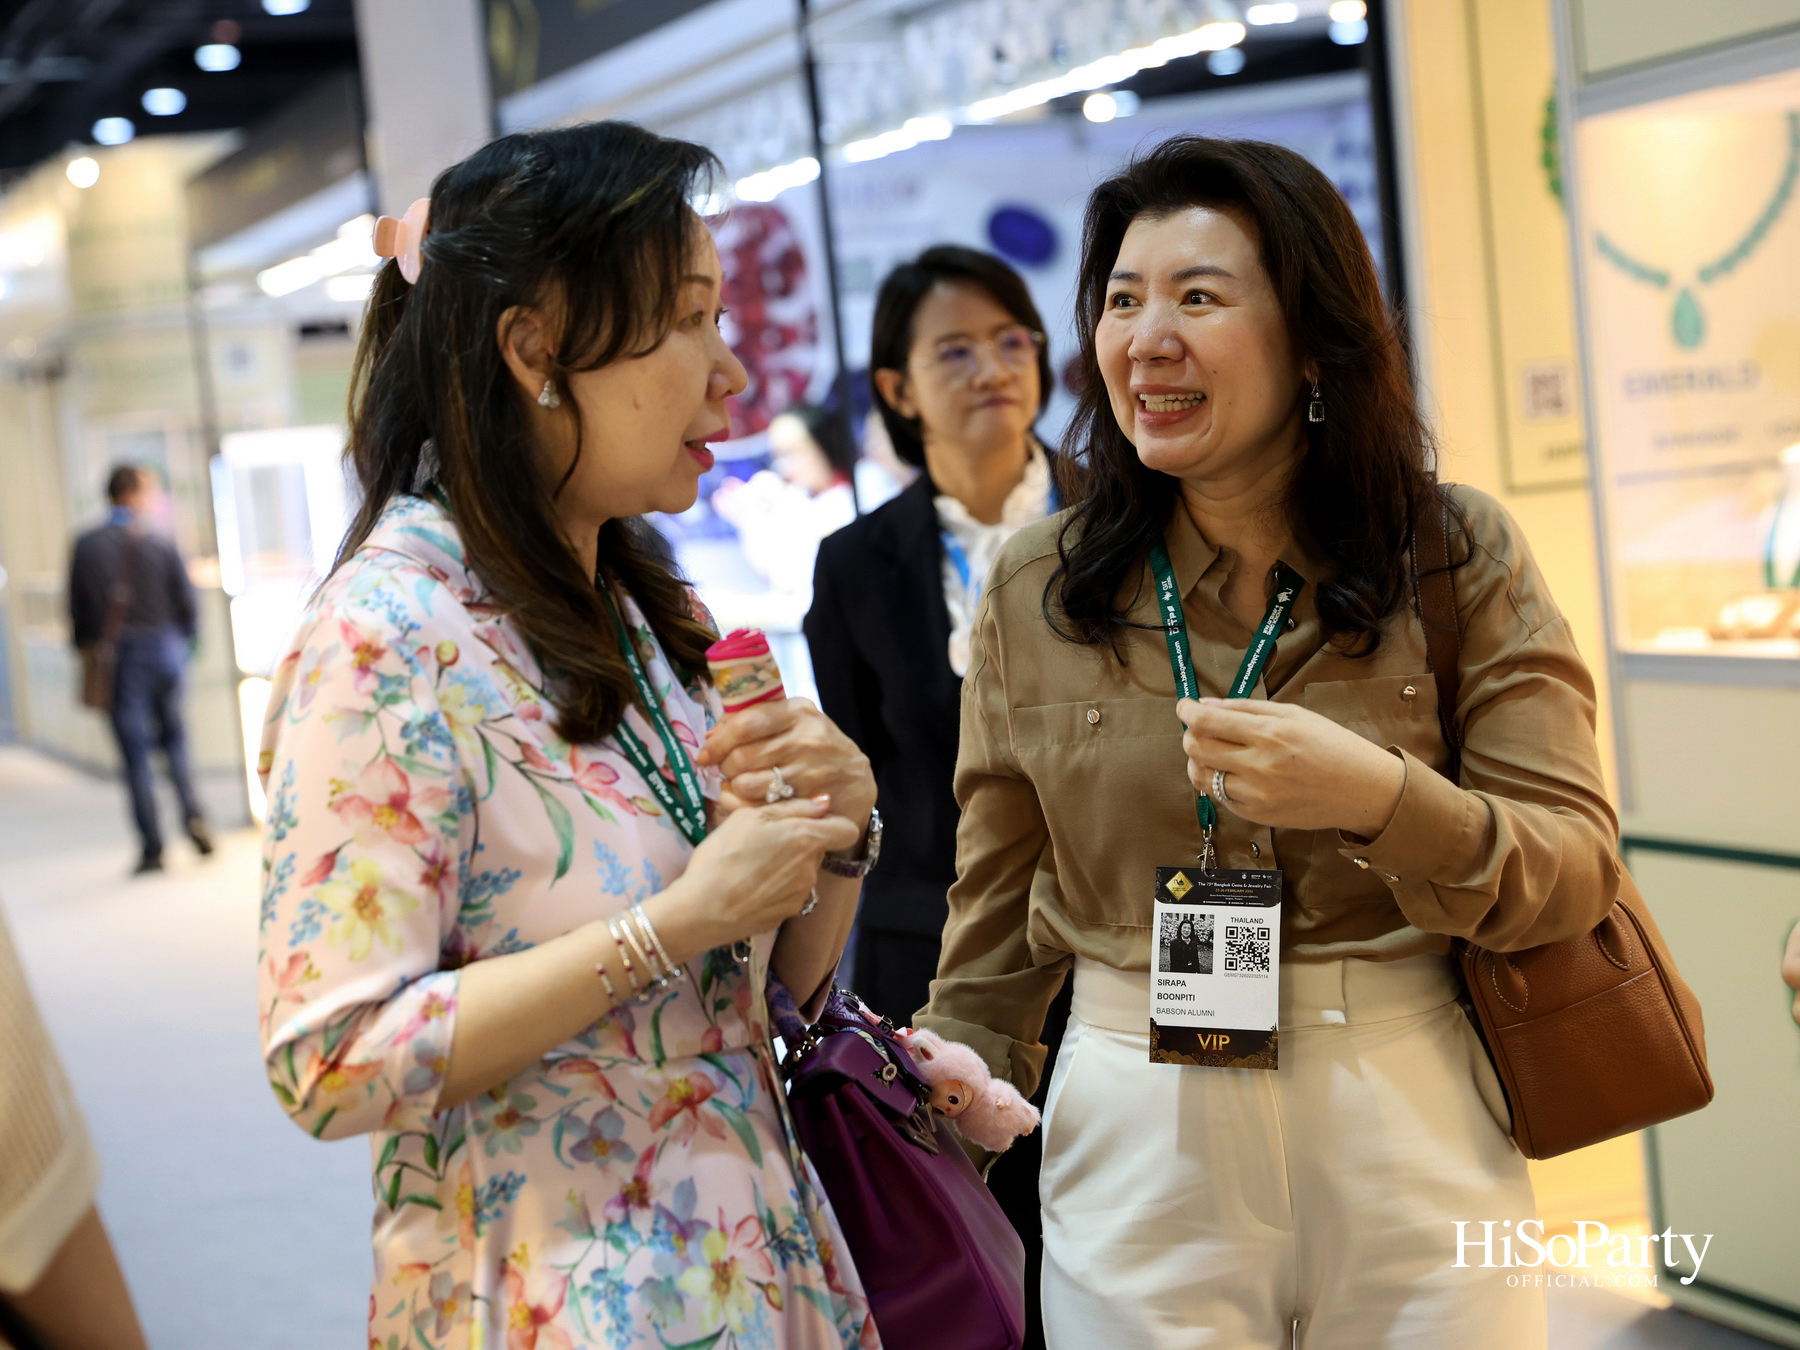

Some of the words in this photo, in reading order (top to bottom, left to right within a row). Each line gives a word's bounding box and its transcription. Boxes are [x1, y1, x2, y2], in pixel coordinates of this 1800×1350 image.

[1237, 639, 1266, 694] www.bkkgems.com
[1230, 916, 1264, 924] THAILAND
[1157, 979, 1187, 988] SIRAPA
[1157, 992, 1196, 1002] BOONPITI
[1156, 1007, 1187, 1016] BABSON
[1187, 1008, 1215, 1017] ALUMNI
[1197, 1033, 1231, 1051] VIP
